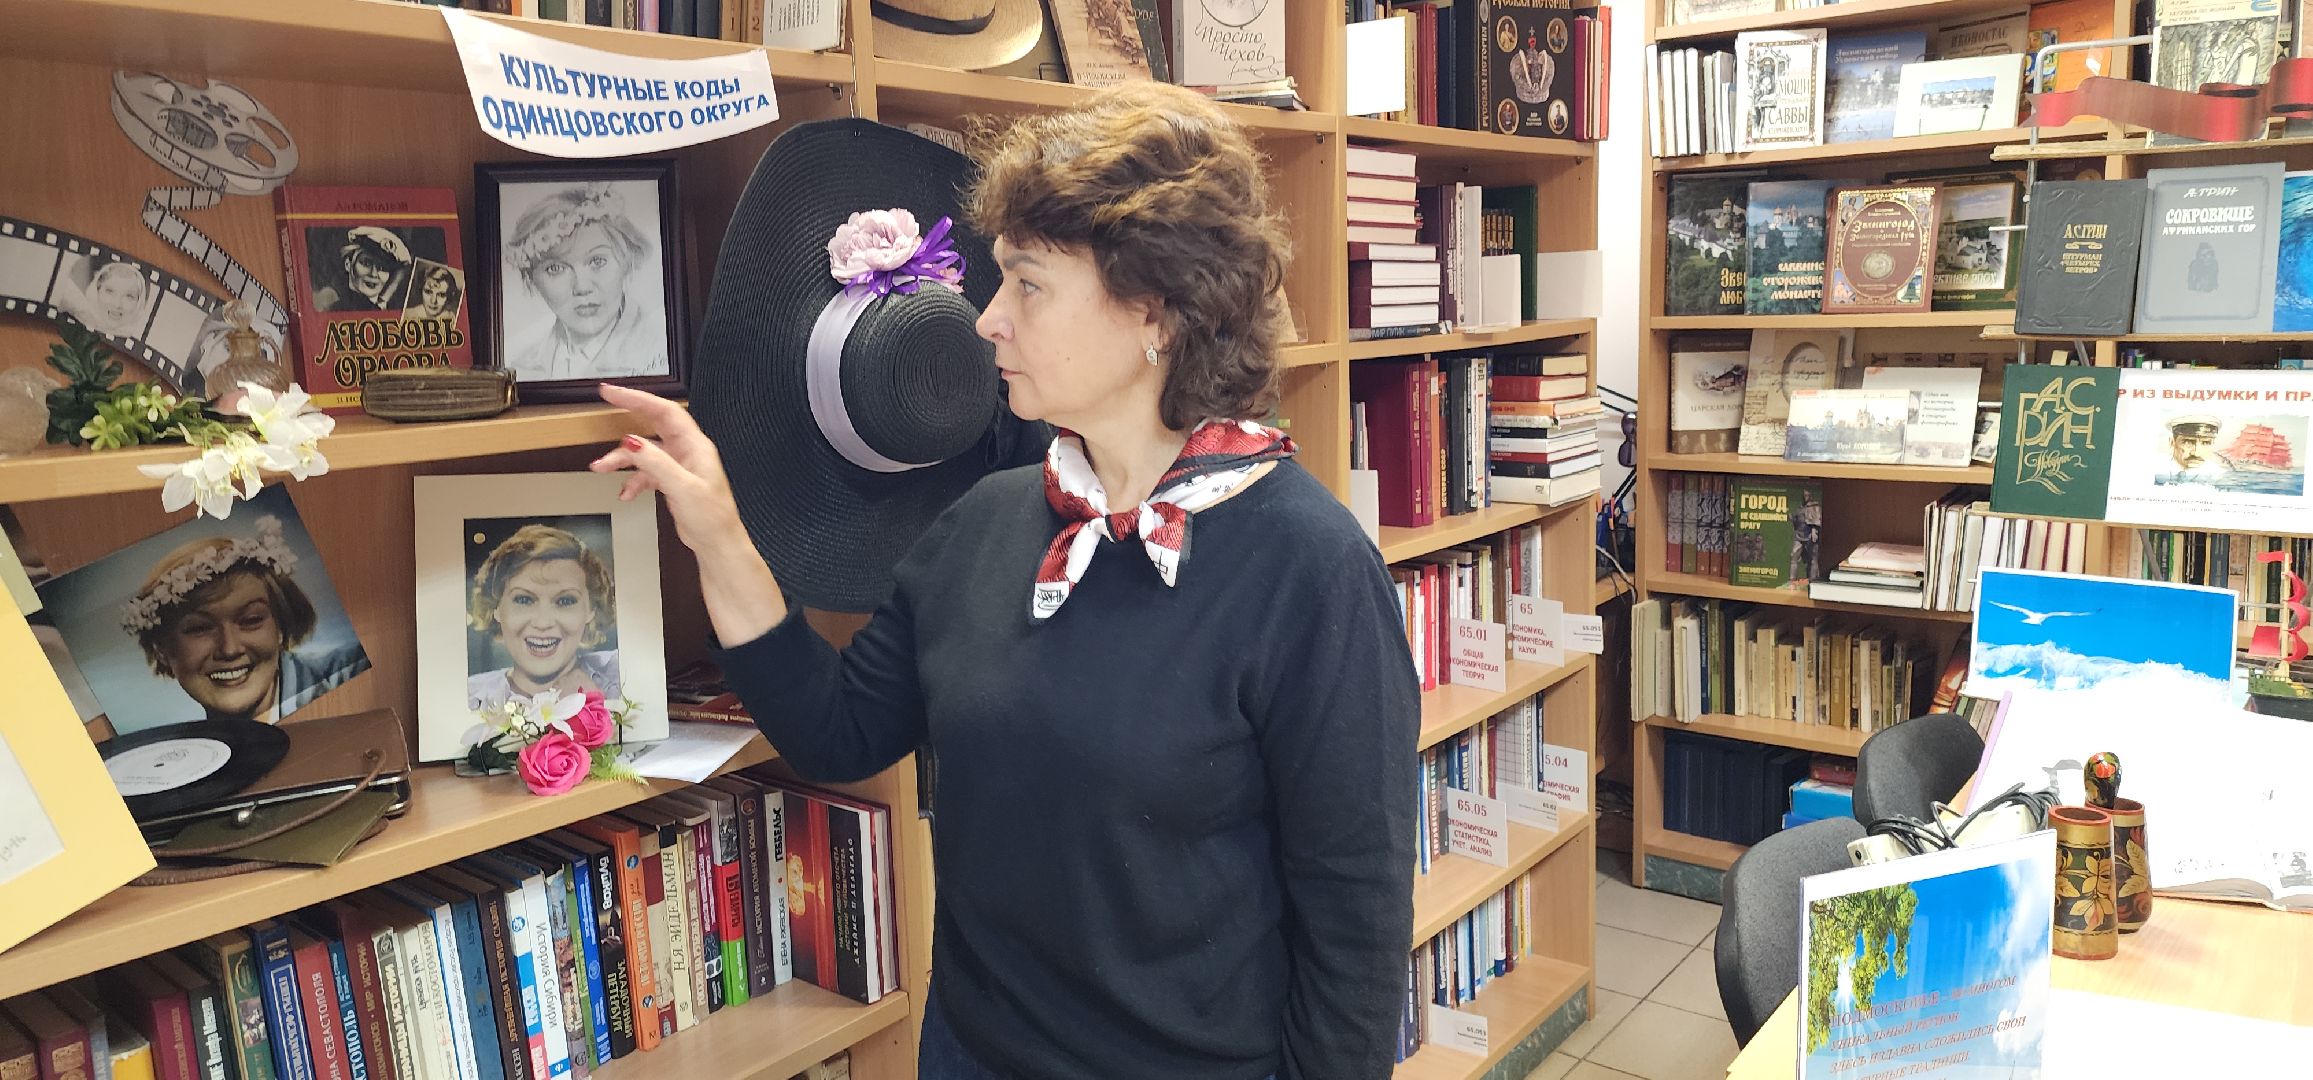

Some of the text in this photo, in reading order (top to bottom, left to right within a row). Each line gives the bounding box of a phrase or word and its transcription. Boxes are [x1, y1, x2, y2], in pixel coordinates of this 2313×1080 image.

[499, 52, 741, 101] КУЛЬТУРНЫЕ КОДЫ
[1778, 79, 1810, 97] МОЩИ
[482, 93, 770, 142] ОДИНЦОВСКОГО ОКРУГА
[1768, 108, 1808, 125] САВВЫ
[2165, 205, 2255, 224] СОКРОВИЩЕ
[2237, 224, 2256, 233] ГОР
[315, 318, 465, 366] ЛЮБОВЬ
[2133, 389, 2156, 399] ИЗ
[2162, 389, 2259, 402] ВЫДУМКИ
[2265, 390, 2279, 401] И
[2285, 390, 2313, 402] ПР
[1740, 494, 1789, 513] ГОРОД
[1520, 602, 1533, 615] 65
[1459, 626, 1487, 641] 65.01
[1463, 648, 1485, 659] ОБЩАЯ
[1462, 669, 1485, 681] ТЕОРИЯ
[1545, 754, 1568, 768] 5.04
[1457, 799, 1488, 817] 65.05
[773, 807, 784, 862] ГЕББЕЛЬС
[599, 855, 613, 911] Бушков
[662, 850, 684, 944] ЭЙДЕЛЬМАН
[384, 963, 403, 1023] ИСТОРИИ
[535, 921, 557, 1029] История Сибири
[311, 971, 336, 1059] СЕВАСТОПОЛЯ
[607, 972, 623, 1032] ПЕТЕРБУРГ
[617, 958, 634, 1039] ЗАГАДОЧНЫЙ
[1829, 991, 1940, 1028] ПОДМОСКОВЬЕ
[343, 1009, 368, 1080] СТОПОЛЬ
[1829, 1016, 2028, 1075] ЗДЕСЬ ИЗДАВНА СЛОЖИЛИСЬ СВОИ
[1830, 1012, 1961, 1052] УНИКАЛЬНЫЙ РЕГИОН
[1908, 1050, 1970, 1074] ТРАДИЦИИ
